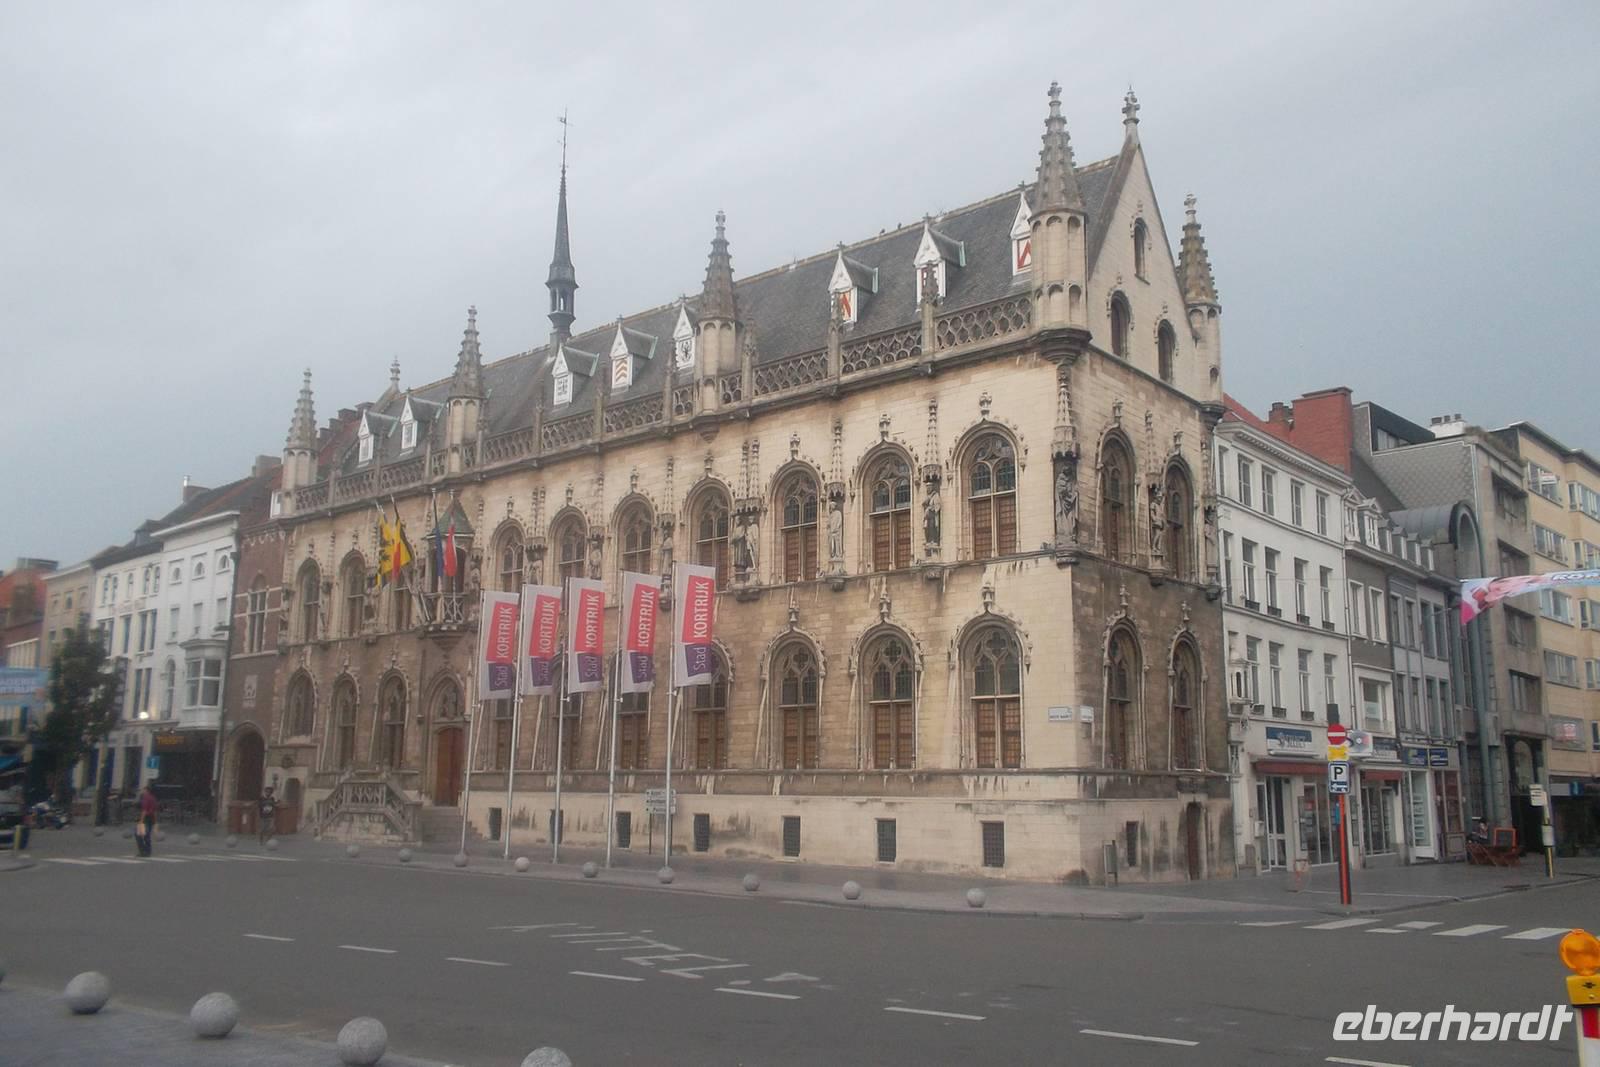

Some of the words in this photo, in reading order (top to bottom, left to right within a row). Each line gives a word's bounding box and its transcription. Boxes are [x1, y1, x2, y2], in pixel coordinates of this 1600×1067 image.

[496, 607, 512, 658] KORTRIJK
[539, 600, 555, 653] KORTRIJK
[585, 594, 600, 648] KORTRIJK
[638, 590, 654, 647] KORTRIJK
[693, 582, 709, 638] KORTRIJK
[694, 647, 706, 672] Stad
[1334, 767, 1344, 780] P
